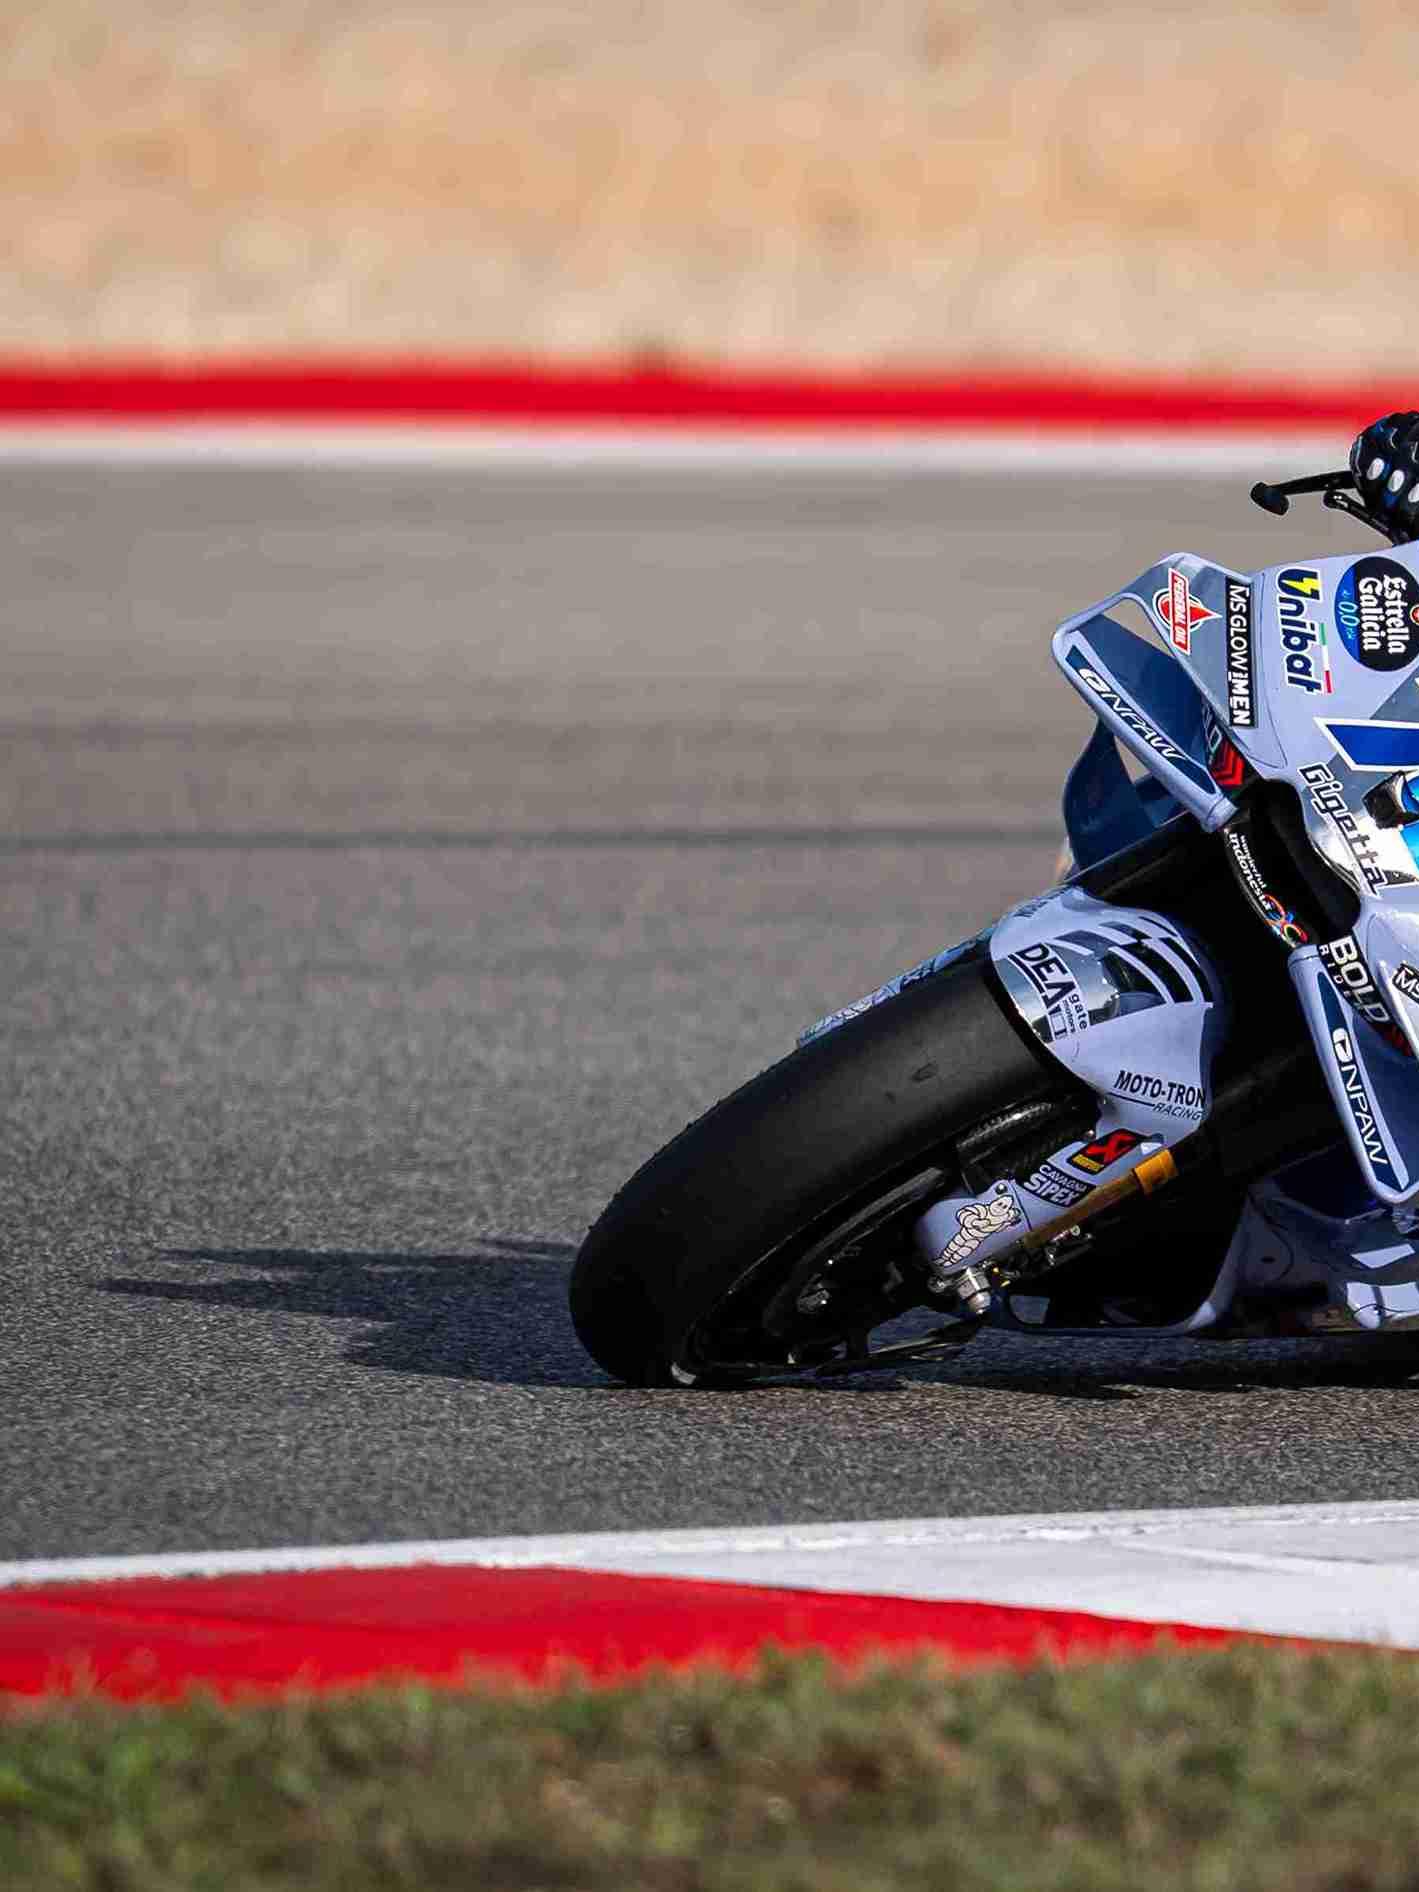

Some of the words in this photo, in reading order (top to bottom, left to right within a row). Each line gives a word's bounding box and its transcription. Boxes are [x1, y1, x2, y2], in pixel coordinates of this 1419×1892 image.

[1277, 567, 1324, 696] Unibat
[1359, 577, 1386, 651] Galicia
[1384, 574, 1410, 654] Estrella
[1298, 763, 1386, 898] Gigetta
[1069, 993, 1088, 1030] gate
[1328, 936, 1389, 1024] BOLD
[1113, 1070, 1207, 1108] MOTO-TRON
[1153, 1102, 1203, 1122] RACING
